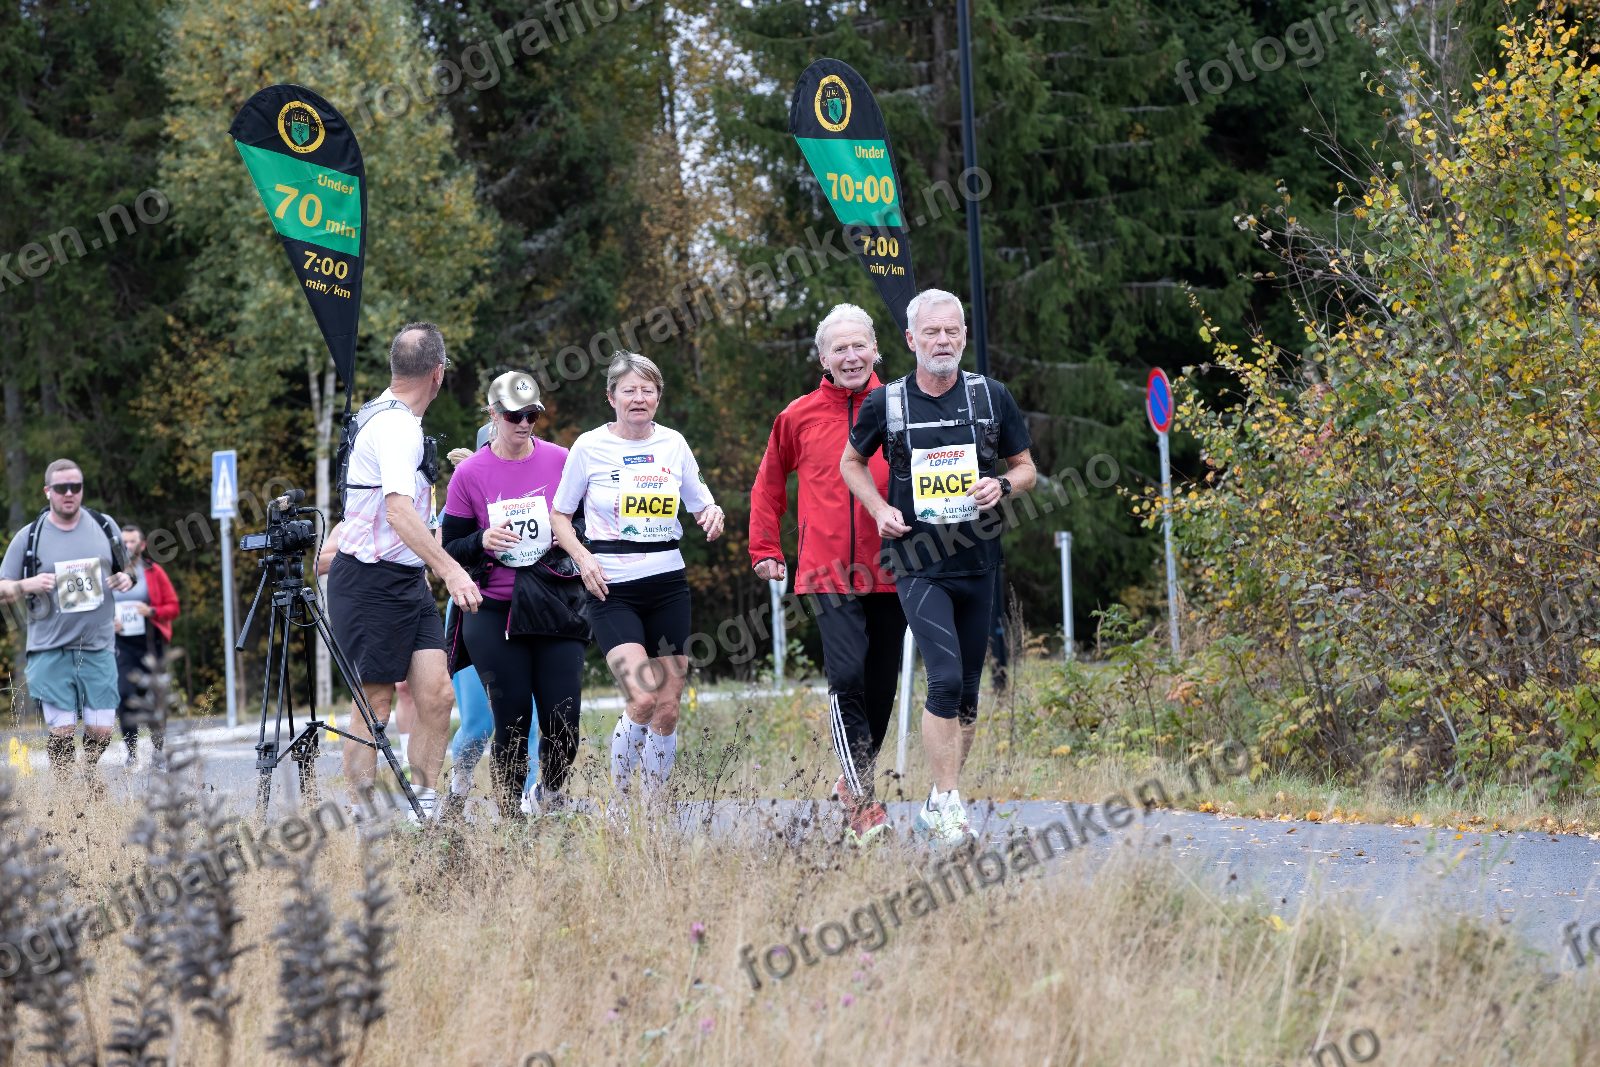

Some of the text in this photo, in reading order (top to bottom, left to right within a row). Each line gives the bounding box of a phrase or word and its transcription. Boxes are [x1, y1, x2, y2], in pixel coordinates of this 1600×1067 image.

[854, 146, 884, 158] Under
[318, 174, 354, 195] Under
[827, 173, 894, 204] 70:00
[275, 184, 355, 238] 70 min
[861, 235, 899, 257] 7:00
[303, 250, 348, 279] 7:00
[869, 262, 905, 276] min/km
[305, 278, 350, 298] min/km
[926, 451, 965, 460] NORGES
[930, 458, 959, 466] LØPET
[633, 475, 669, 483] NORGES
[920, 473, 972, 496] PACE
[503, 502, 536, 511] NORGES
[505, 508, 531, 517] LØPET
[625, 496, 673, 514] PACE
[942, 505, 978, 514] Aurskog
[643, 525, 672, 535] Aurskog
[66, 577, 93, 593] 693
